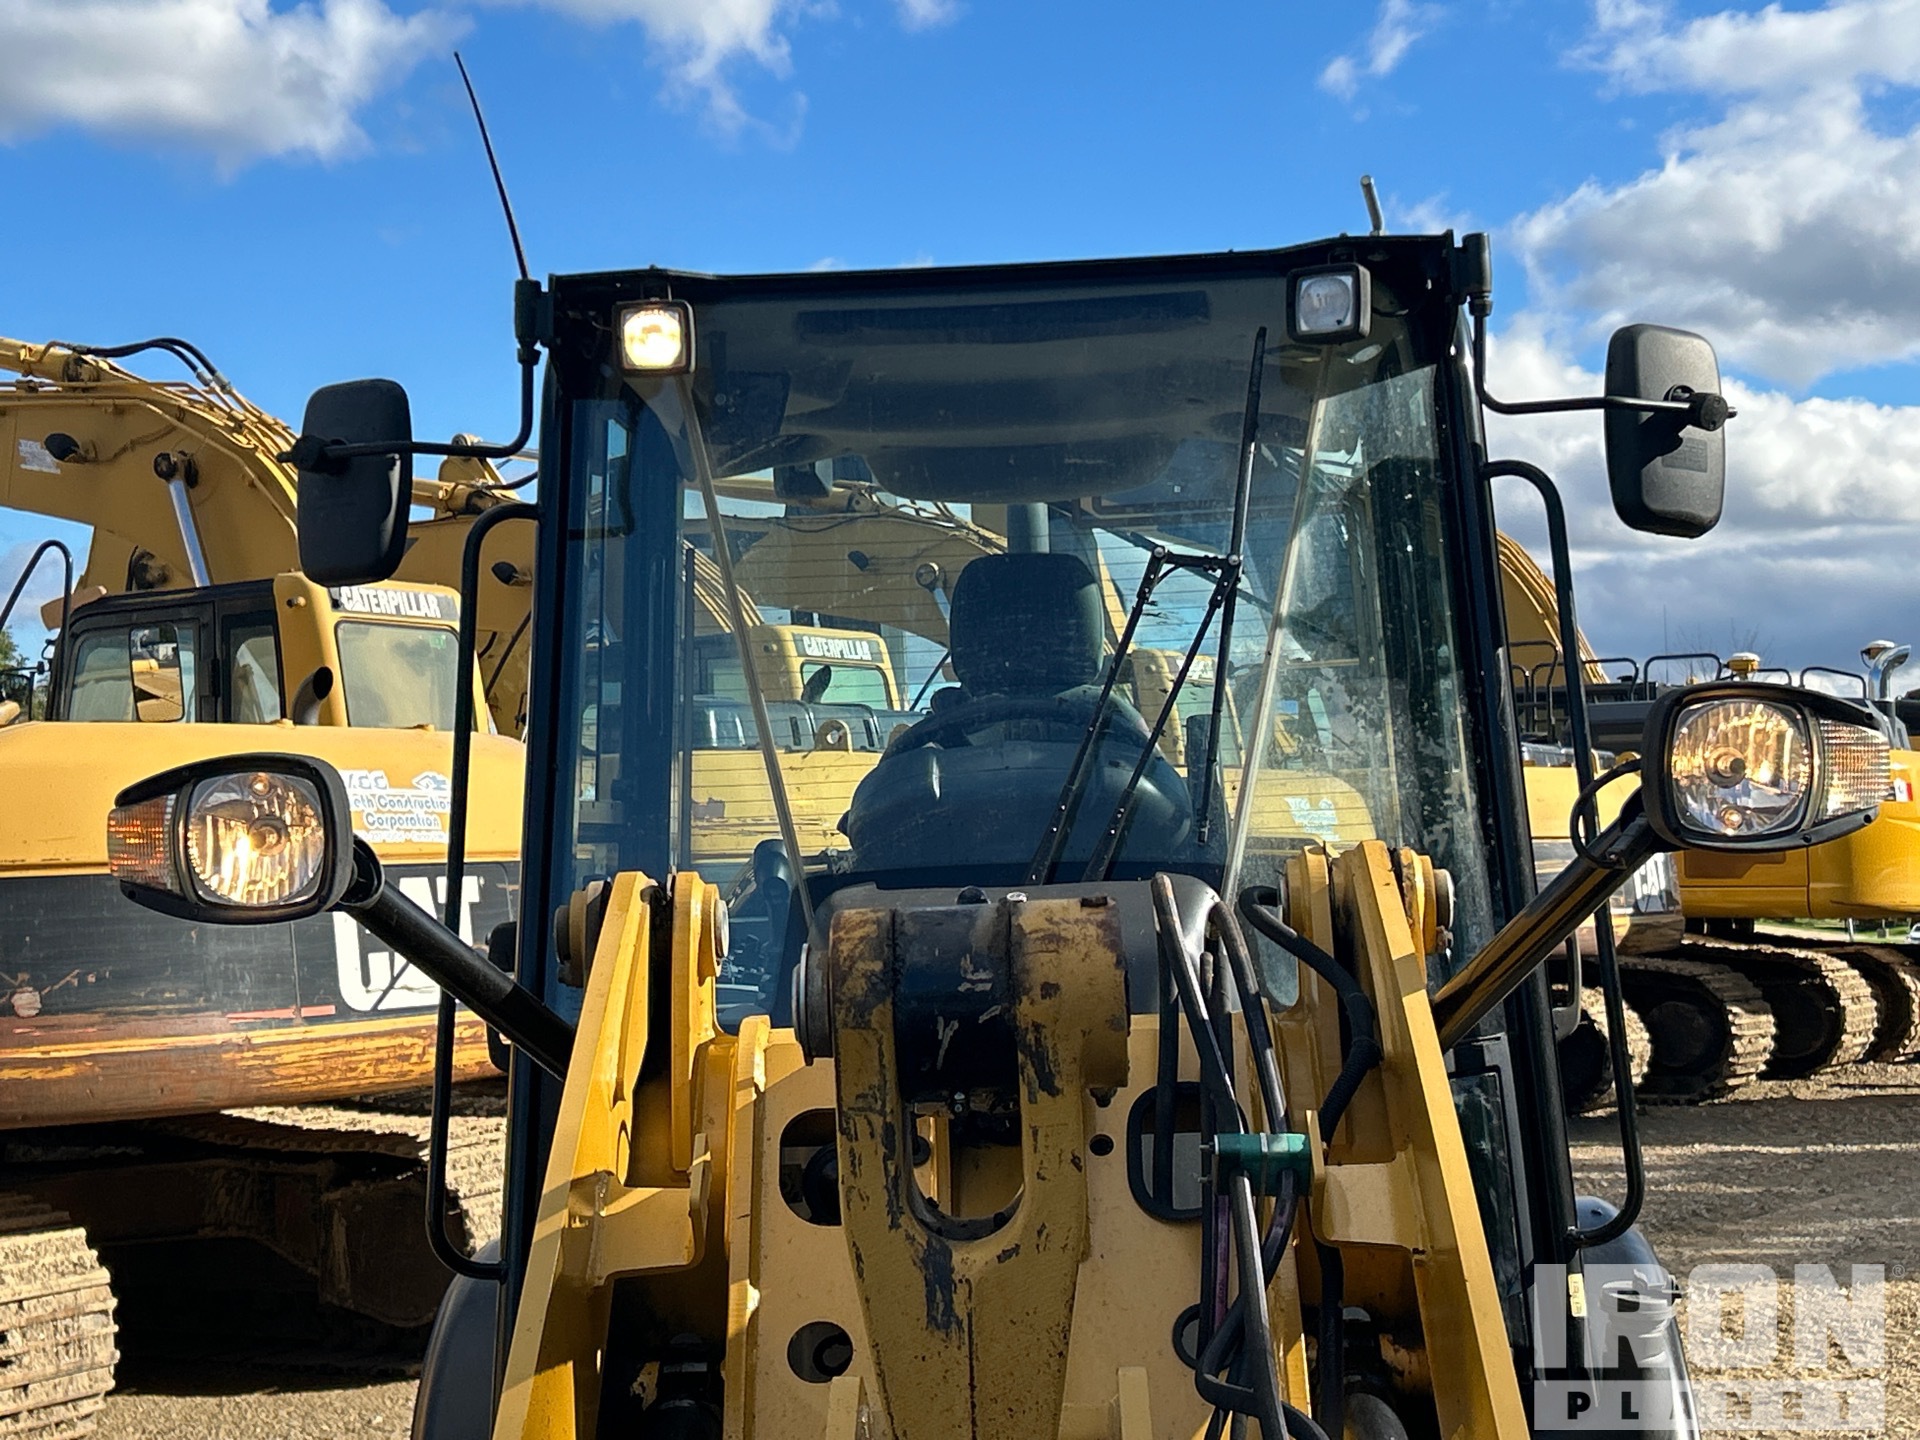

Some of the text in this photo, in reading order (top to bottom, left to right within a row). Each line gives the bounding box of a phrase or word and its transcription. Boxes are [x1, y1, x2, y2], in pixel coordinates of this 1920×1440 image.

[340, 586, 441, 618] CATERPILLAR
[802, 635, 872, 661] CATERPILLAR
[365, 811, 440, 830] Corporation
[1633, 852, 1667, 912] CAT
